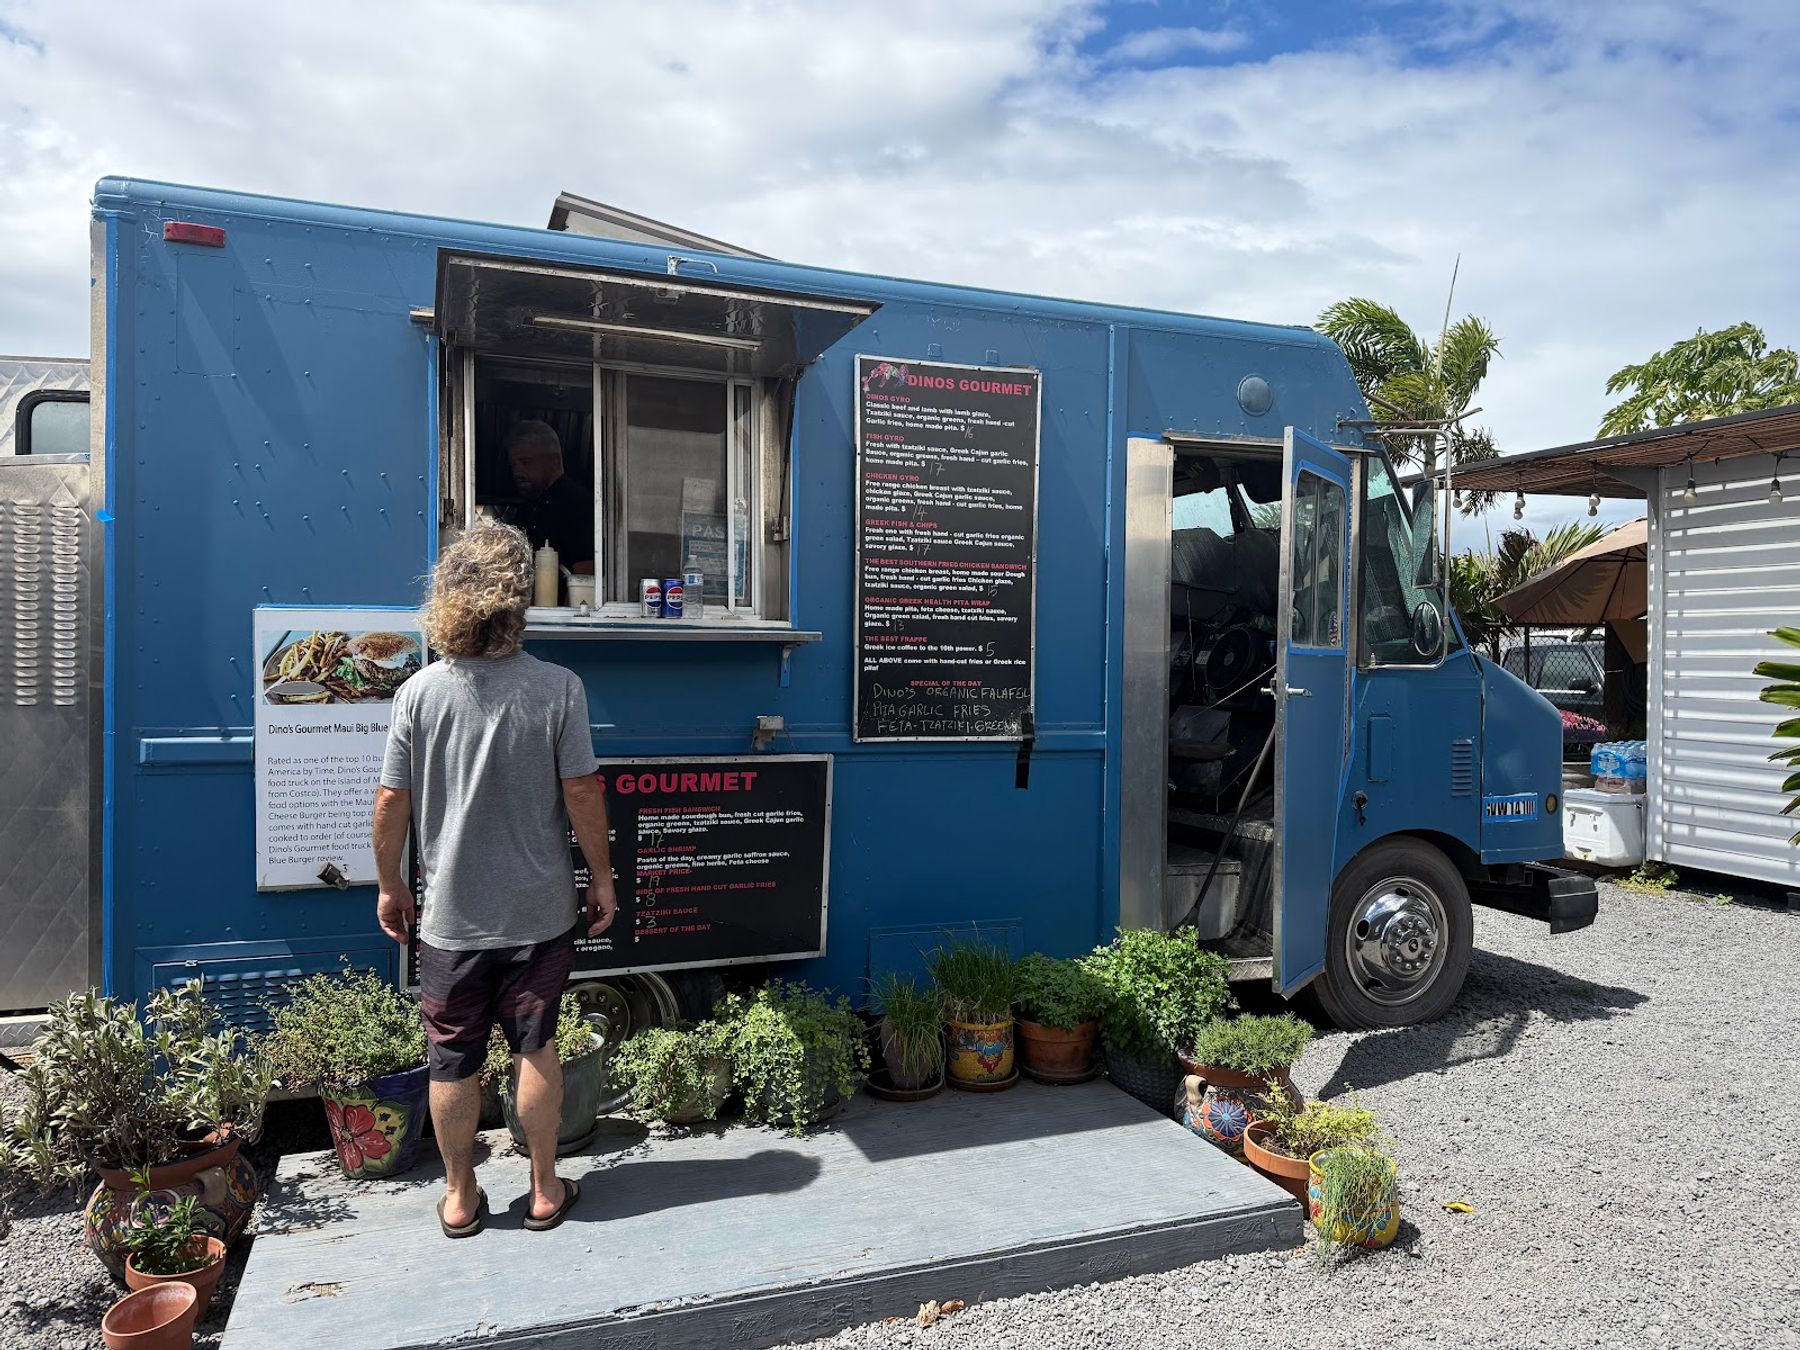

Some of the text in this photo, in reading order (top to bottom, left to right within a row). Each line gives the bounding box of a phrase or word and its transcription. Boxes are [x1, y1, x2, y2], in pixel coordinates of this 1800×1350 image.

[907, 375, 1031, 395] DINOS GOURMET
[866, 393, 910, 403] DINOS GYRO
[866, 401, 889, 409] Classic
[892, 403, 906, 411] beef
[972, 410, 990, 418] glaze,
[916, 521, 938, 529] CHIPS
[873, 702, 991, 718] PITA GARLIC FRIES
[269, 723, 388, 734] Dino's Gourmet Maui Big Blue
[345, 755, 359, 764] top
[303, 768, 312, 777] by
[338, 766, 361, 774] Dino's
[268, 779, 286, 787] food
[616, 772, 757, 794] GOURMET
[268, 790, 287, 798] from
[322, 789, 341, 797] They
[269, 801, 287, 809] food
[290, 801, 319, 810] options
[269, 812, 297, 820] Cheese
[300, 812, 327, 821] Burger
[329, 811, 350, 819] being
[353, 810, 366, 818] top
[316, 821, 336, 829] hand
[269, 834, 298, 842] cooked
[269, 845, 292, 853] Dino's
[295, 844, 329, 852] Gourmet
[288, 856, 314, 865] Burger
[635, 927, 668, 935] DESSERT
